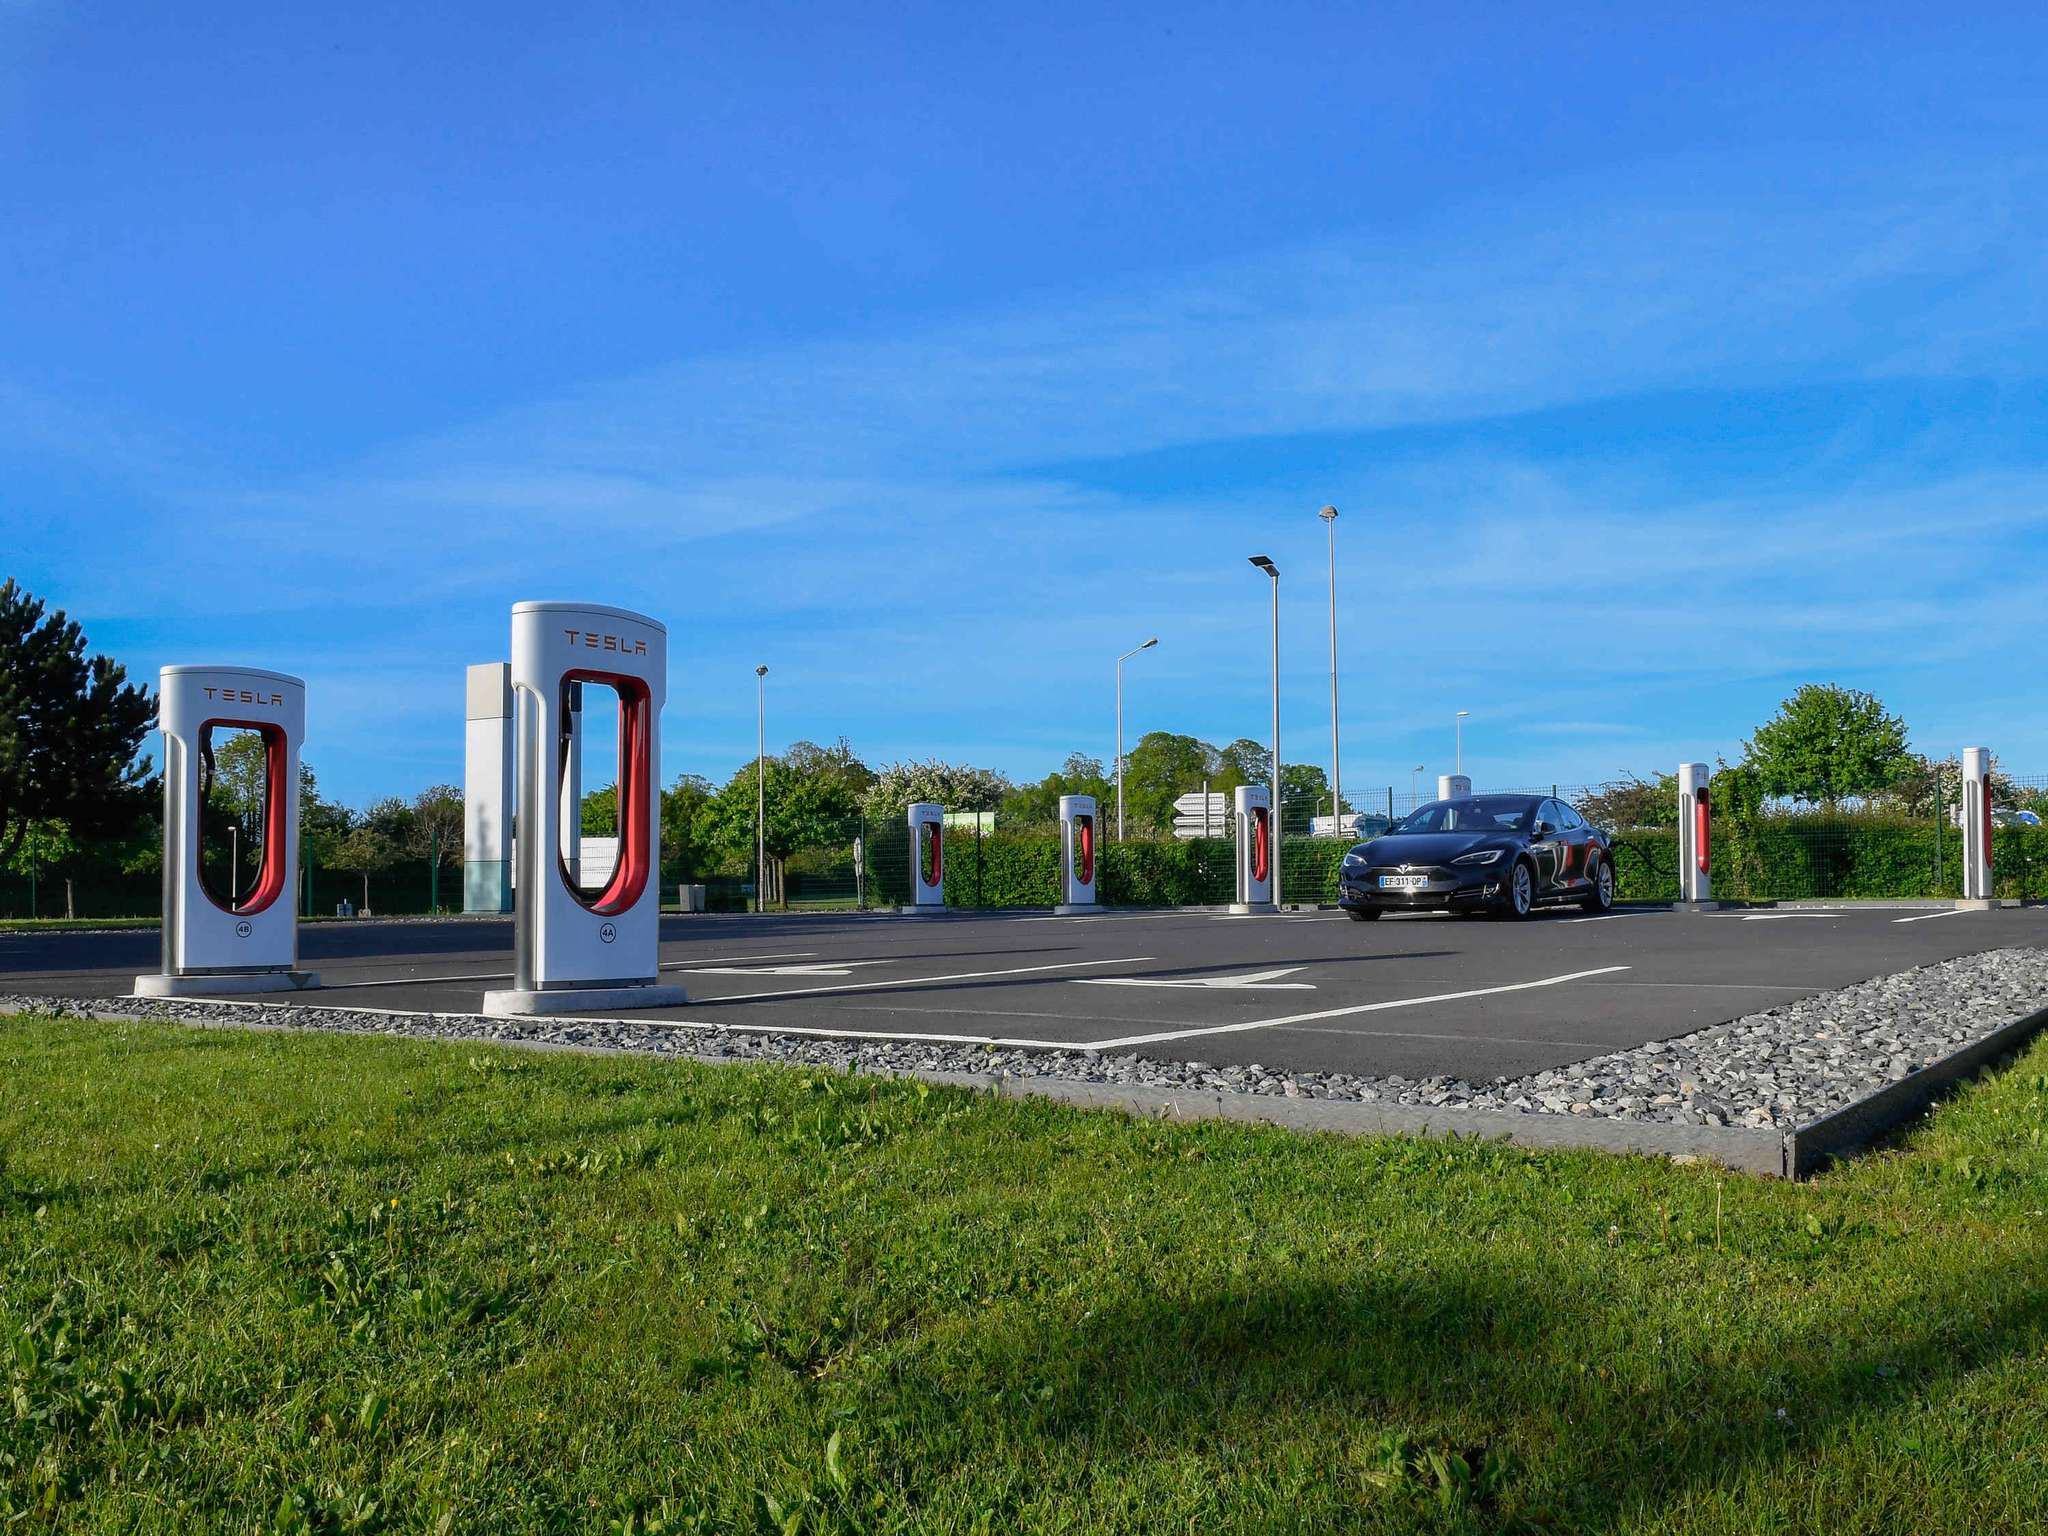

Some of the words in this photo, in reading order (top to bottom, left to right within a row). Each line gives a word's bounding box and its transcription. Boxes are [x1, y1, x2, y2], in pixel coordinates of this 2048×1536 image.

[564, 630, 647, 656] TESLA
[203, 687, 283, 706] TESLA
[238, 925, 250, 933] 4B
[602, 929, 614, 937] 4A
